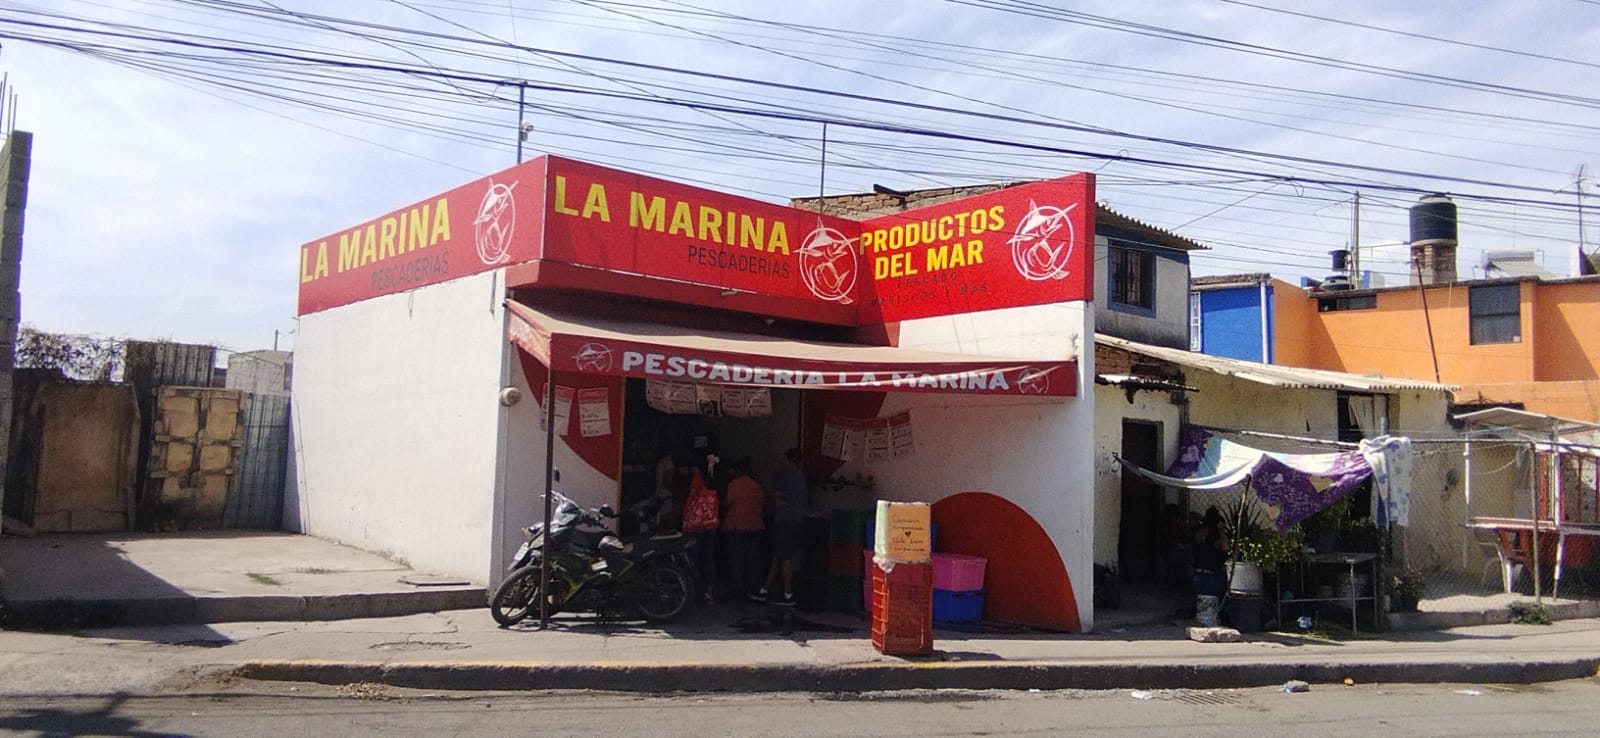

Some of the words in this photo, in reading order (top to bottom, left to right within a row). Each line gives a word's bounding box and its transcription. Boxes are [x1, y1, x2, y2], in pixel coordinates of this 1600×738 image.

[554, 175, 610, 222] LA
[629, 191, 790, 256] MARINA
[859, 205, 1005, 255] PRODUCTOS
[301, 240, 328, 284] LA
[338, 198, 451, 273] MARINA
[875, 253, 917, 280] DEL
[926, 239, 983, 272] MAR
[371, 250, 449, 290] PESCADERIAS
[687, 245, 790, 279] PESCADERIAS
[622, 351, 825, 385] PESCADERIA
[838, 371, 881, 386] LA
[891, 371, 1009, 390] MARINA
